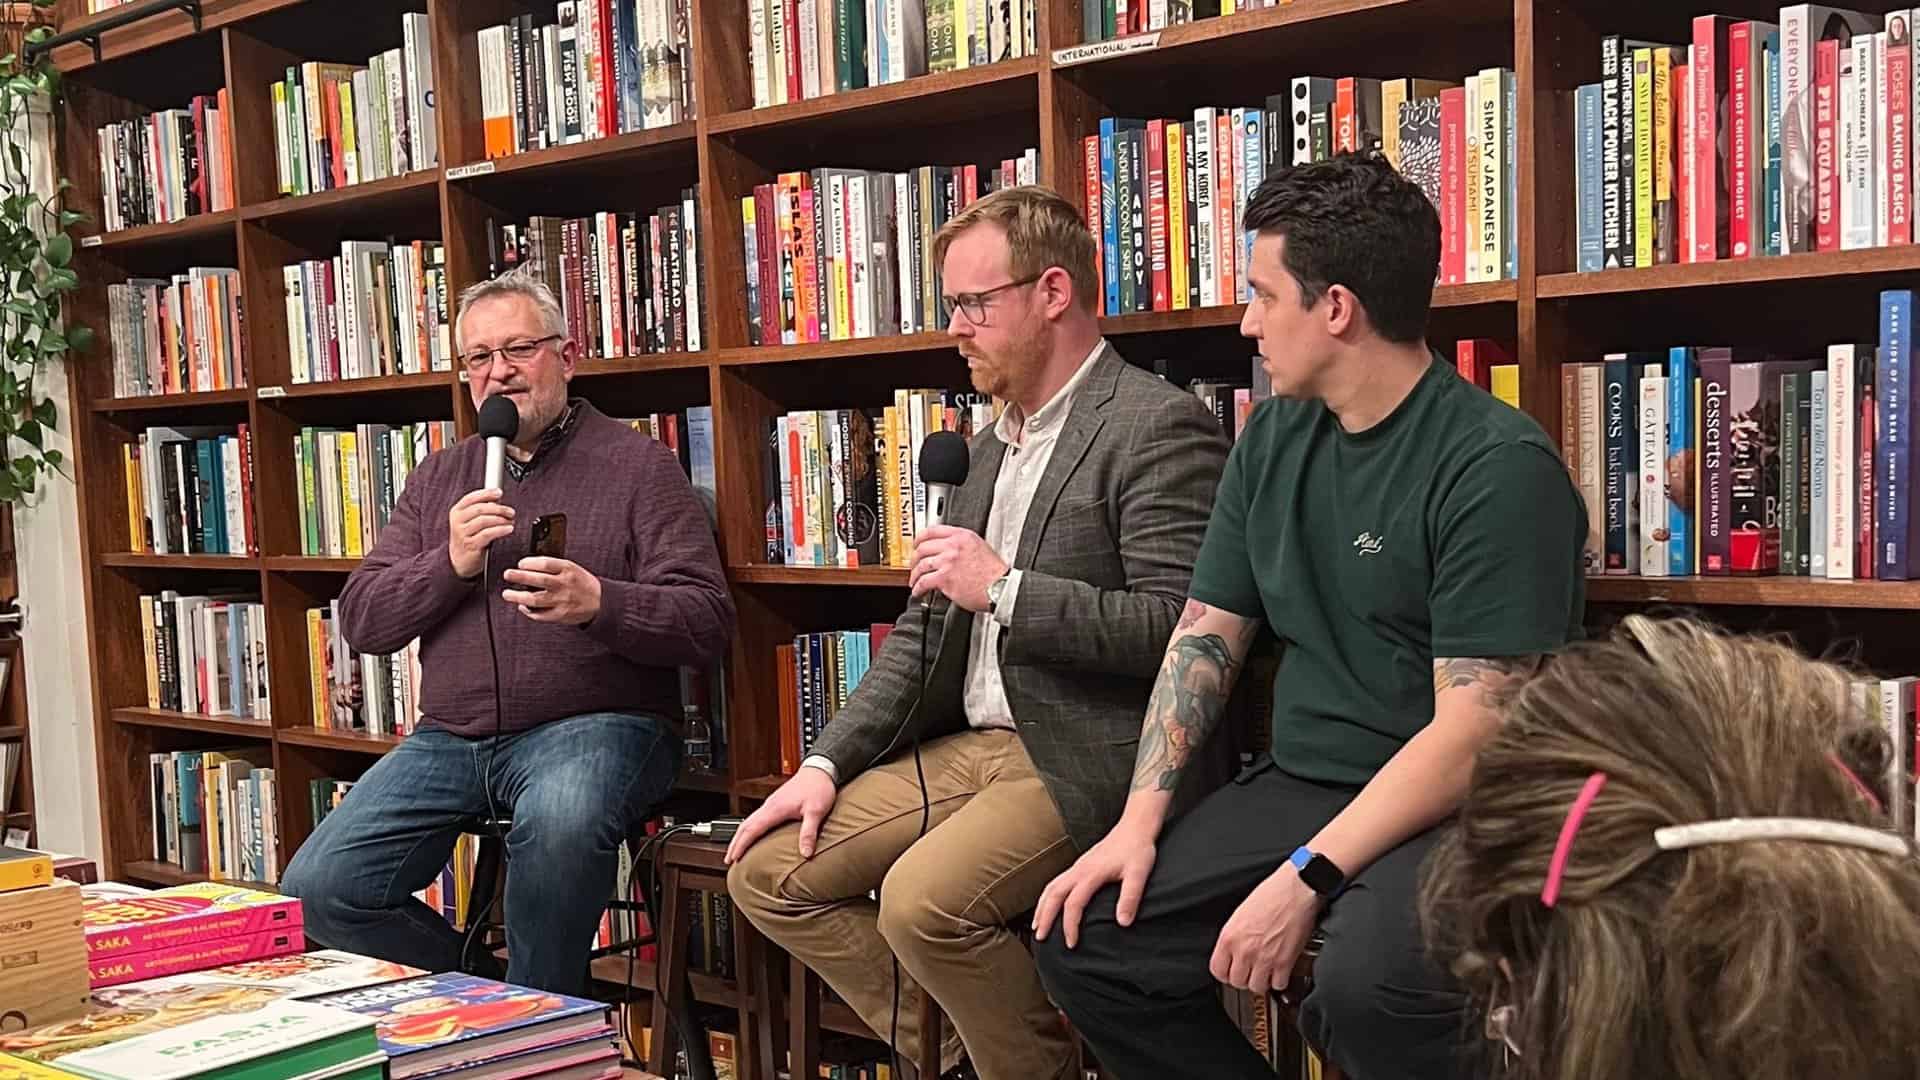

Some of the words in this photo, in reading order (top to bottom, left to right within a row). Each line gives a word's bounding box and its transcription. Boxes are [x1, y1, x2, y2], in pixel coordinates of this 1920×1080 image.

[1735, 68, 1744, 89] THE
[1786, 19, 1799, 98] EVERYONE
[565, 88, 574, 125] BOOK
[1603, 79, 1617, 129] BLACK
[1735, 92, 1744, 117] HOT
[1818, 84, 1832, 121] PIE
[1340, 113, 1351, 150] TOK
[1484, 100, 1495, 159] SIMPLY
[1638, 127, 1649, 164] HOME
[1735, 119, 1744, 168] CHICKEN
[1893, 114, 1904, 169] BAKING
[1087, 141, 1097, 181] NIGHT
[1197, 151, 1208, 169] MY
[1467, 136, 1480, 212] OTSUMAMI
[1604, 129, 1618, 181] POWER
[1818, 127, 1832, 224] SQUARED
[832, 184, 840, 203] My
[1150, 180, 1164, 199] AM
[1198, 173, 1209, 208] KOREA
[1484, 165, 1495, 252] JAPANESE
[1735, 172, 1744, 219] PROJECT
[1893, 173, 1904, 224] BASICS
[791, 186, 804, 258] ISLAS
[814, 196, 824, 251] PORTUGAL
[834, 208, 842, 254] Lisbon
[1120, 186, 1131, 246] COCONUT
[1132, 193, 1144, 286] AMBOY
[1604, 183, 1620, 249] KITCHEN
[1151, 215, 1166, 271] FILIPINO
[669, 230, 681, 308] MEATHEAD
[1706, 382, 1727, 468] desserts
[899, 445, 911, 495] Israeli
[1607, 447, 1622, 497] baking
[1814, 457, 1825, 499] Nonna
[901, 500, 913, 537] Soul
[1608, 498, 1622, 533] book
[1710, 473, 1719, 536] ILLUSTRATED
[95, 935, 131, 951] SAKA
[98, 963, 135, 979] SAKA
